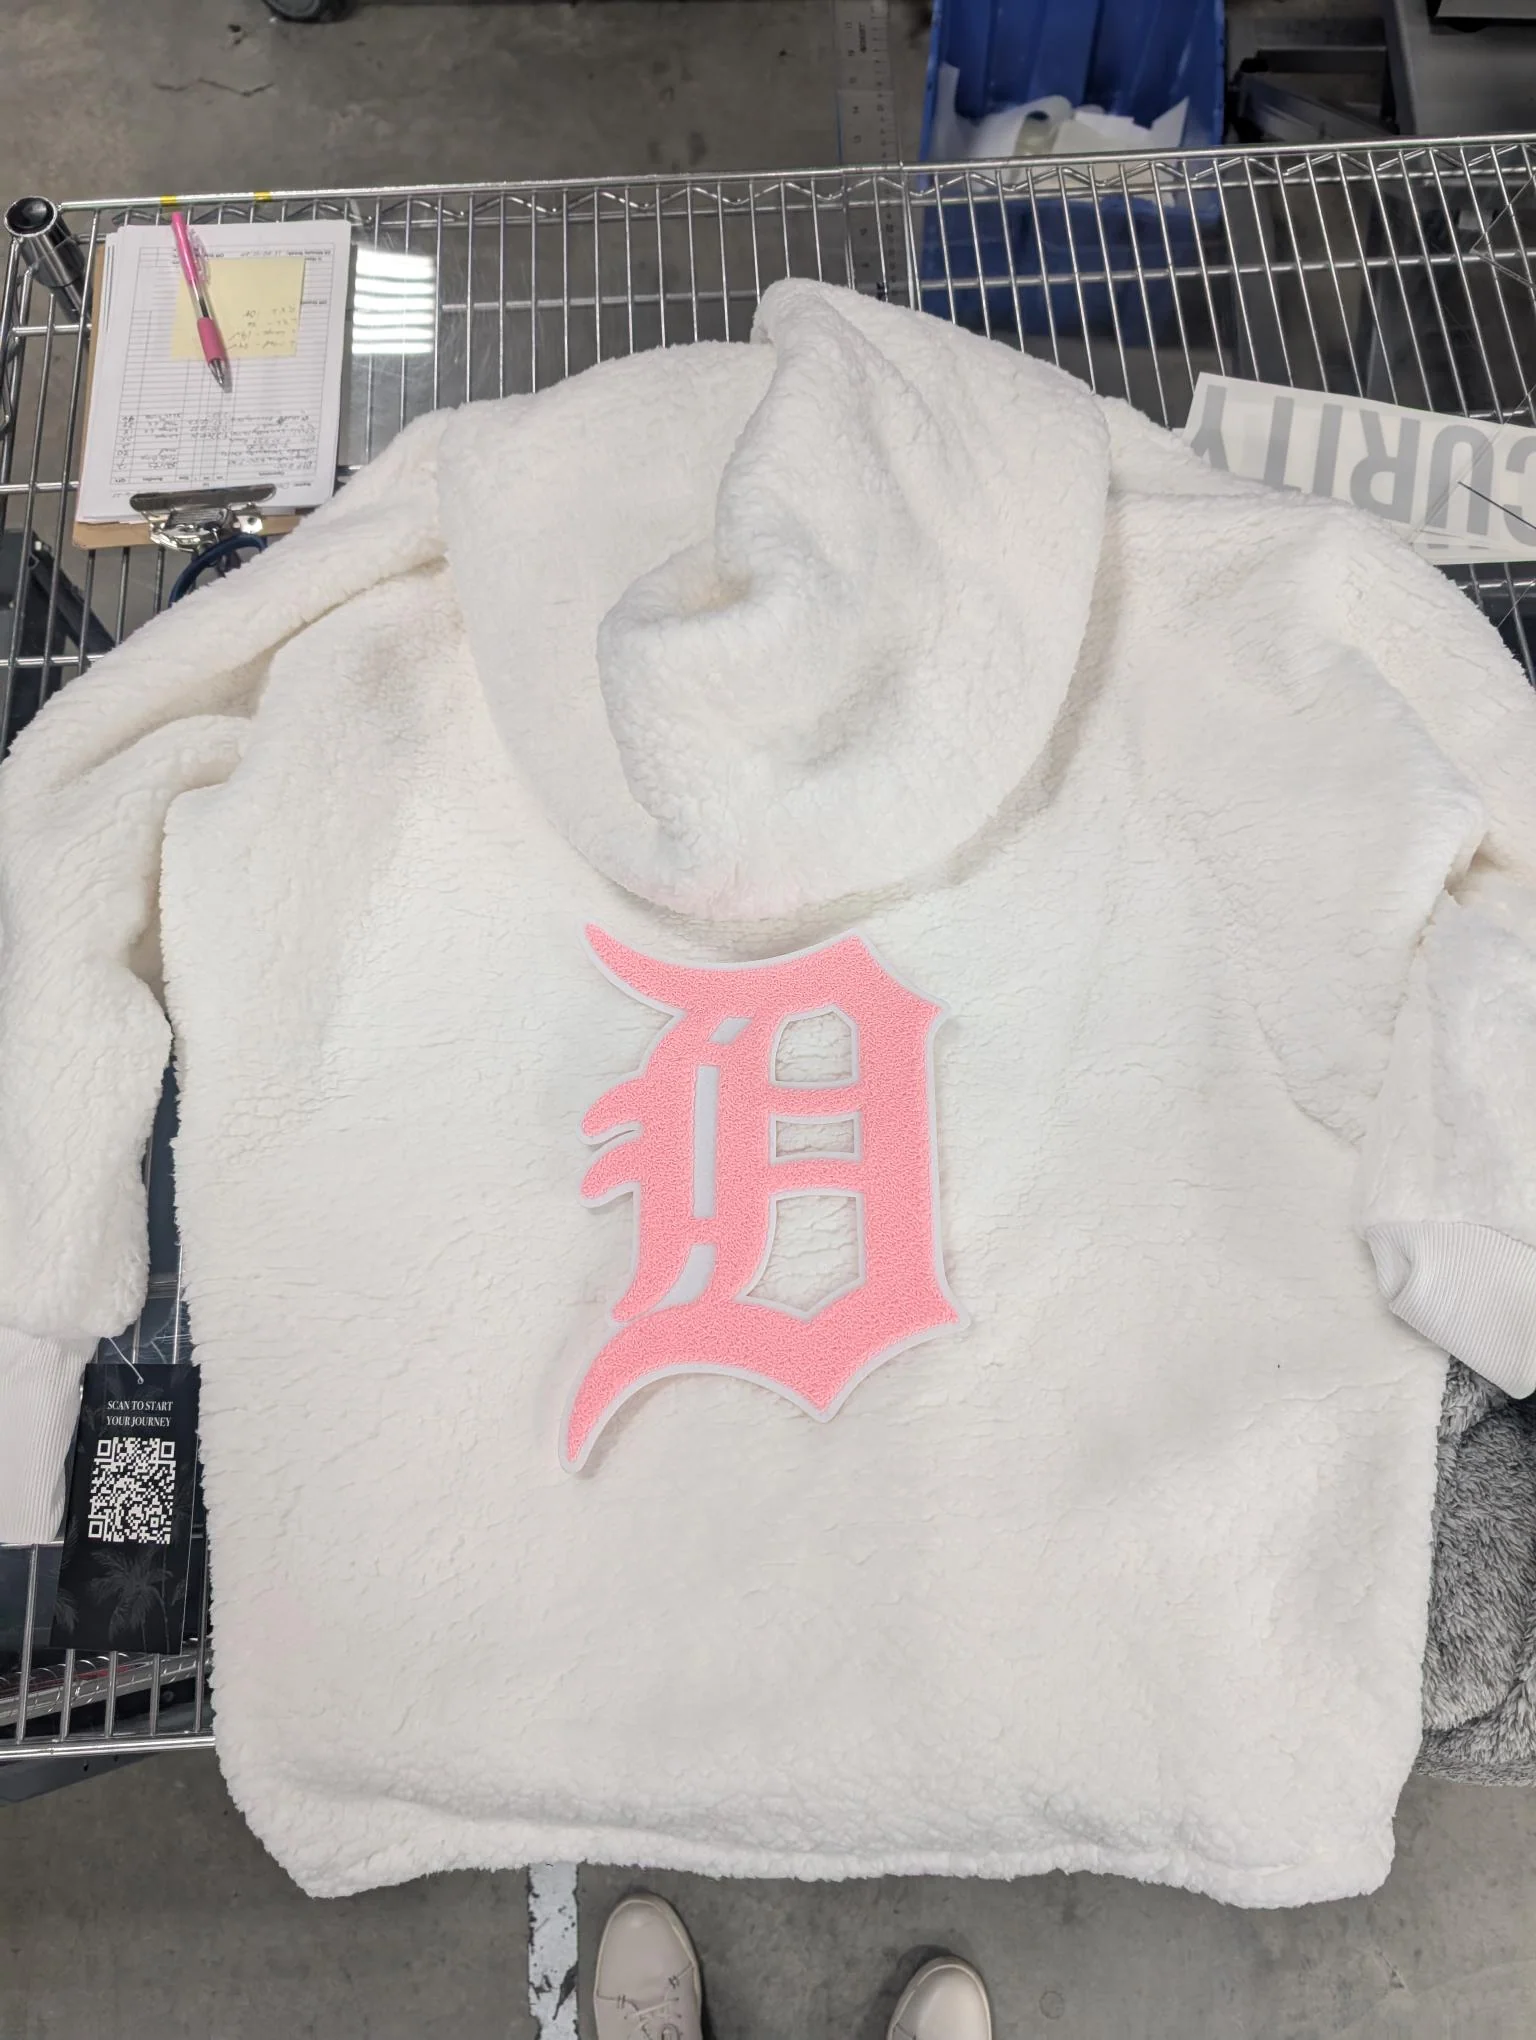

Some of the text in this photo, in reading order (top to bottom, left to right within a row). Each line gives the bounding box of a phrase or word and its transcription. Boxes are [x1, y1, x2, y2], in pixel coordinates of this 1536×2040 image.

[558, 921, 970, 1475] D
[107, 1400, 174, 1412] SCAN TO START
[106, 1415, 171, 1427] YOUR JOURNEY
